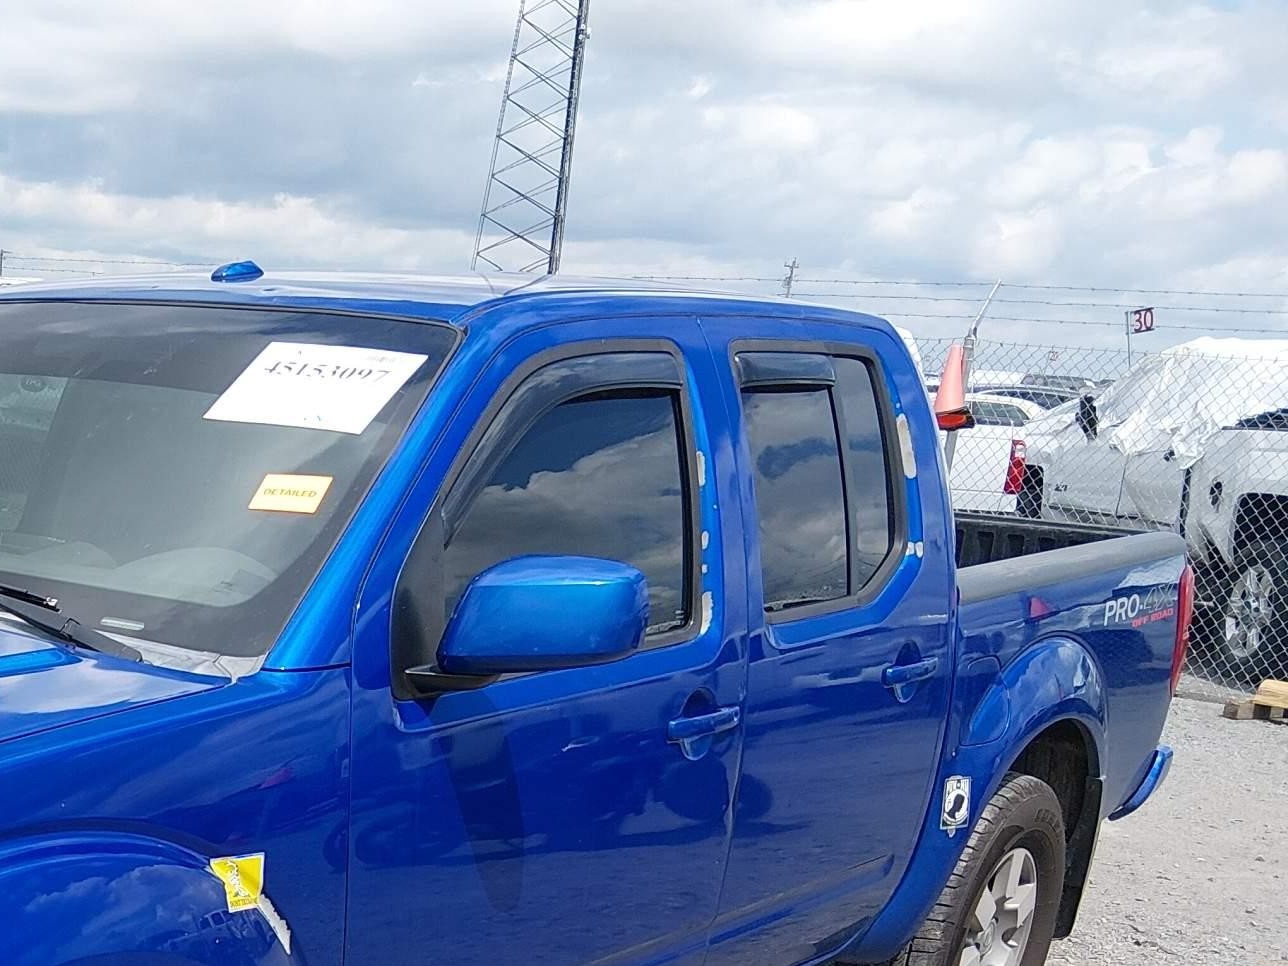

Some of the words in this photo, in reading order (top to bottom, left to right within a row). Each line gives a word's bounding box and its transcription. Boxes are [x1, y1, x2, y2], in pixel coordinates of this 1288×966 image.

[1133, 309, 1155, 332] 30
[263, 487, 318, 498] DETAILED
[1131, 615, 1149, 628] OFF
[1150, 607, 1174, 622] ROAD
